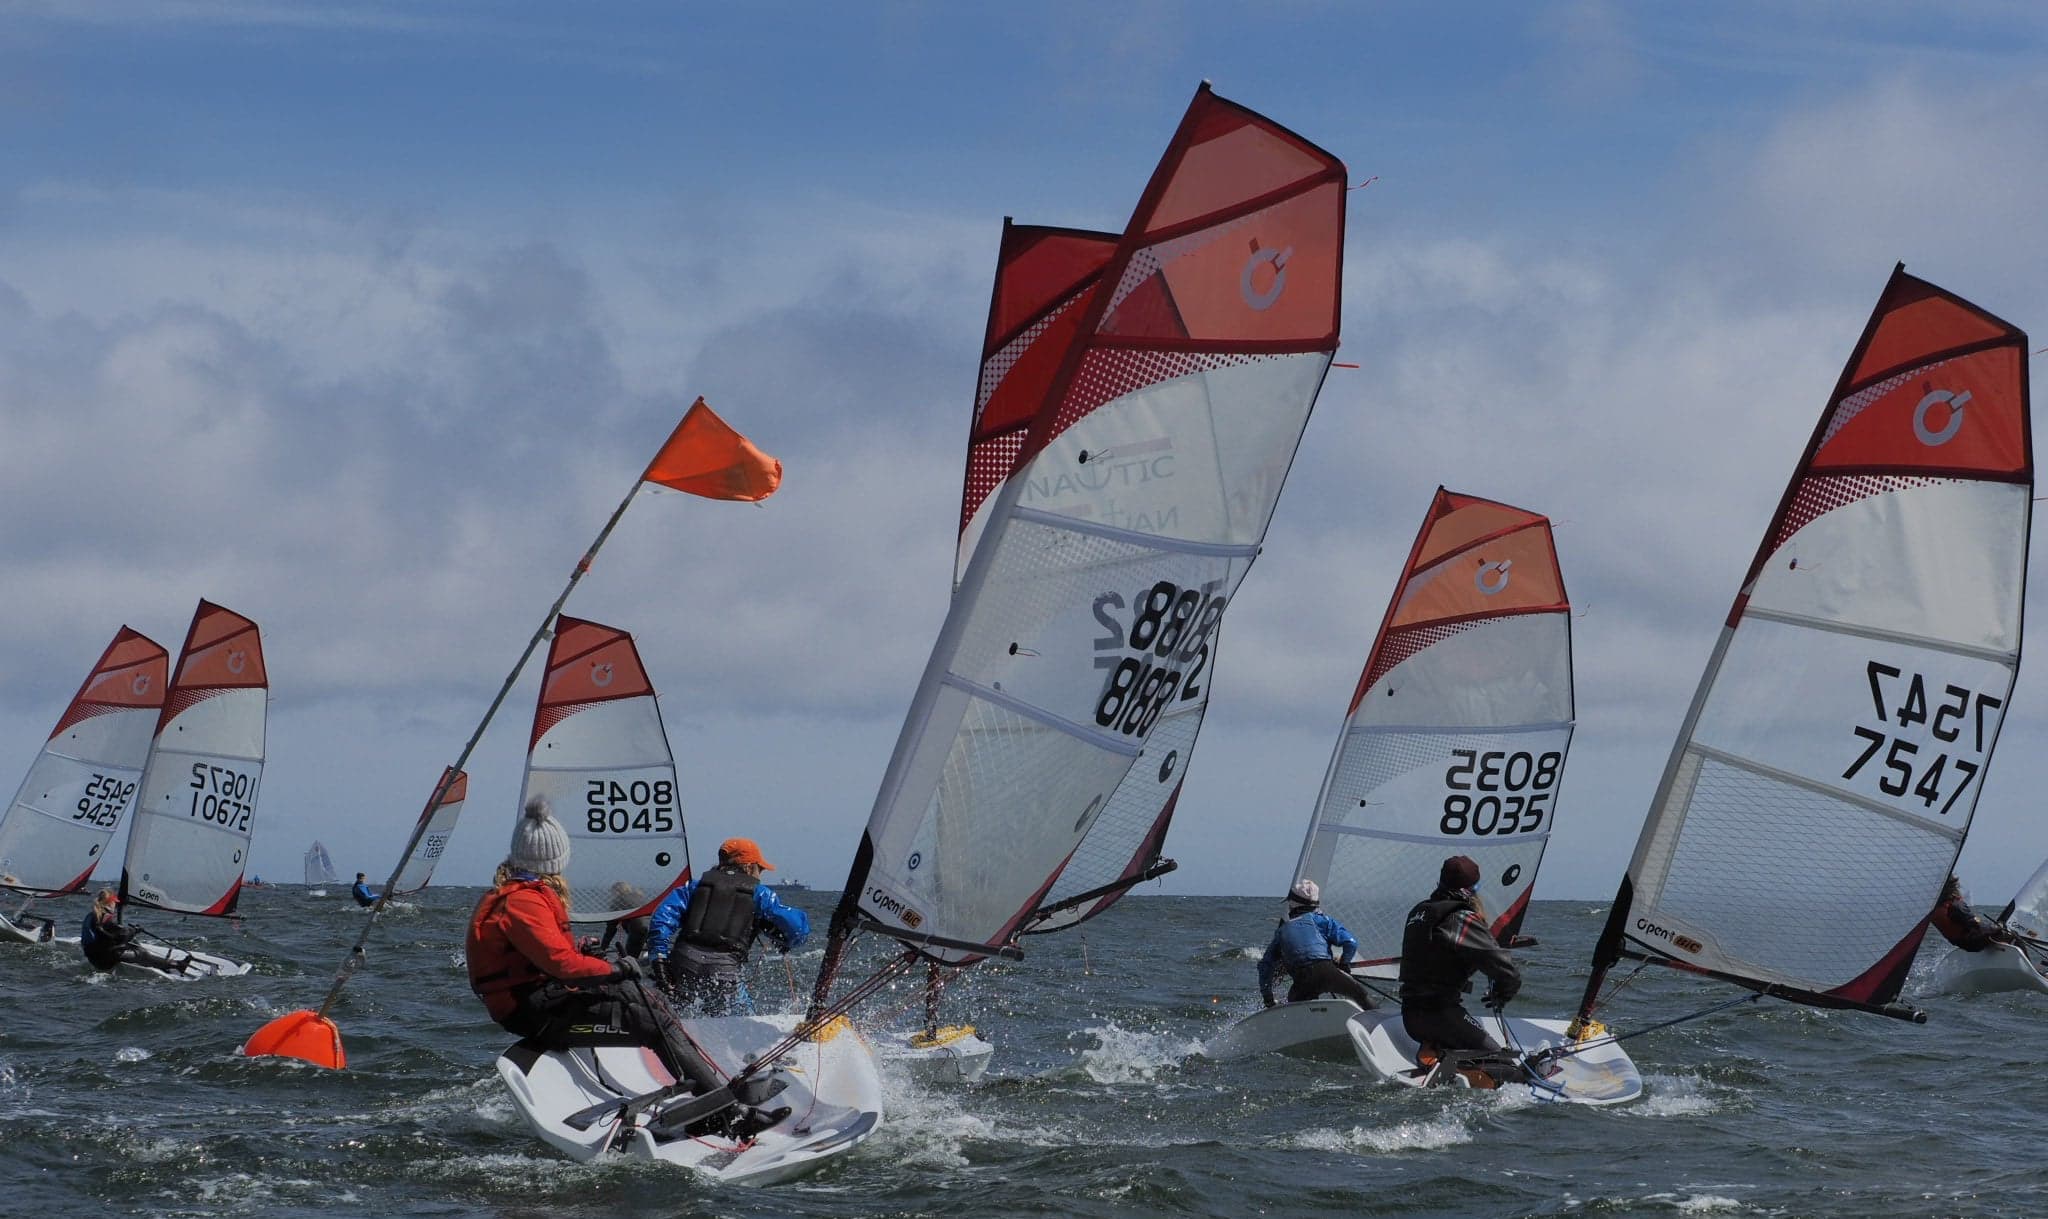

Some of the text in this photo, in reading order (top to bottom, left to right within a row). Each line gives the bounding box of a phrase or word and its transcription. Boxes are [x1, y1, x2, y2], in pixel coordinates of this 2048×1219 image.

[1841, 725, 1980, 815] 7547
[72, 797, 123, 827] 9425
[190, 791, 251, 832] 10672
[587, 807, 674, 834] 8045
[1440, 793, 1550, 836] 8035
[139, 889, 160, 903] Open
[872, 888, 900, 915] Open
[1636, 918, 1668, 940] Open
